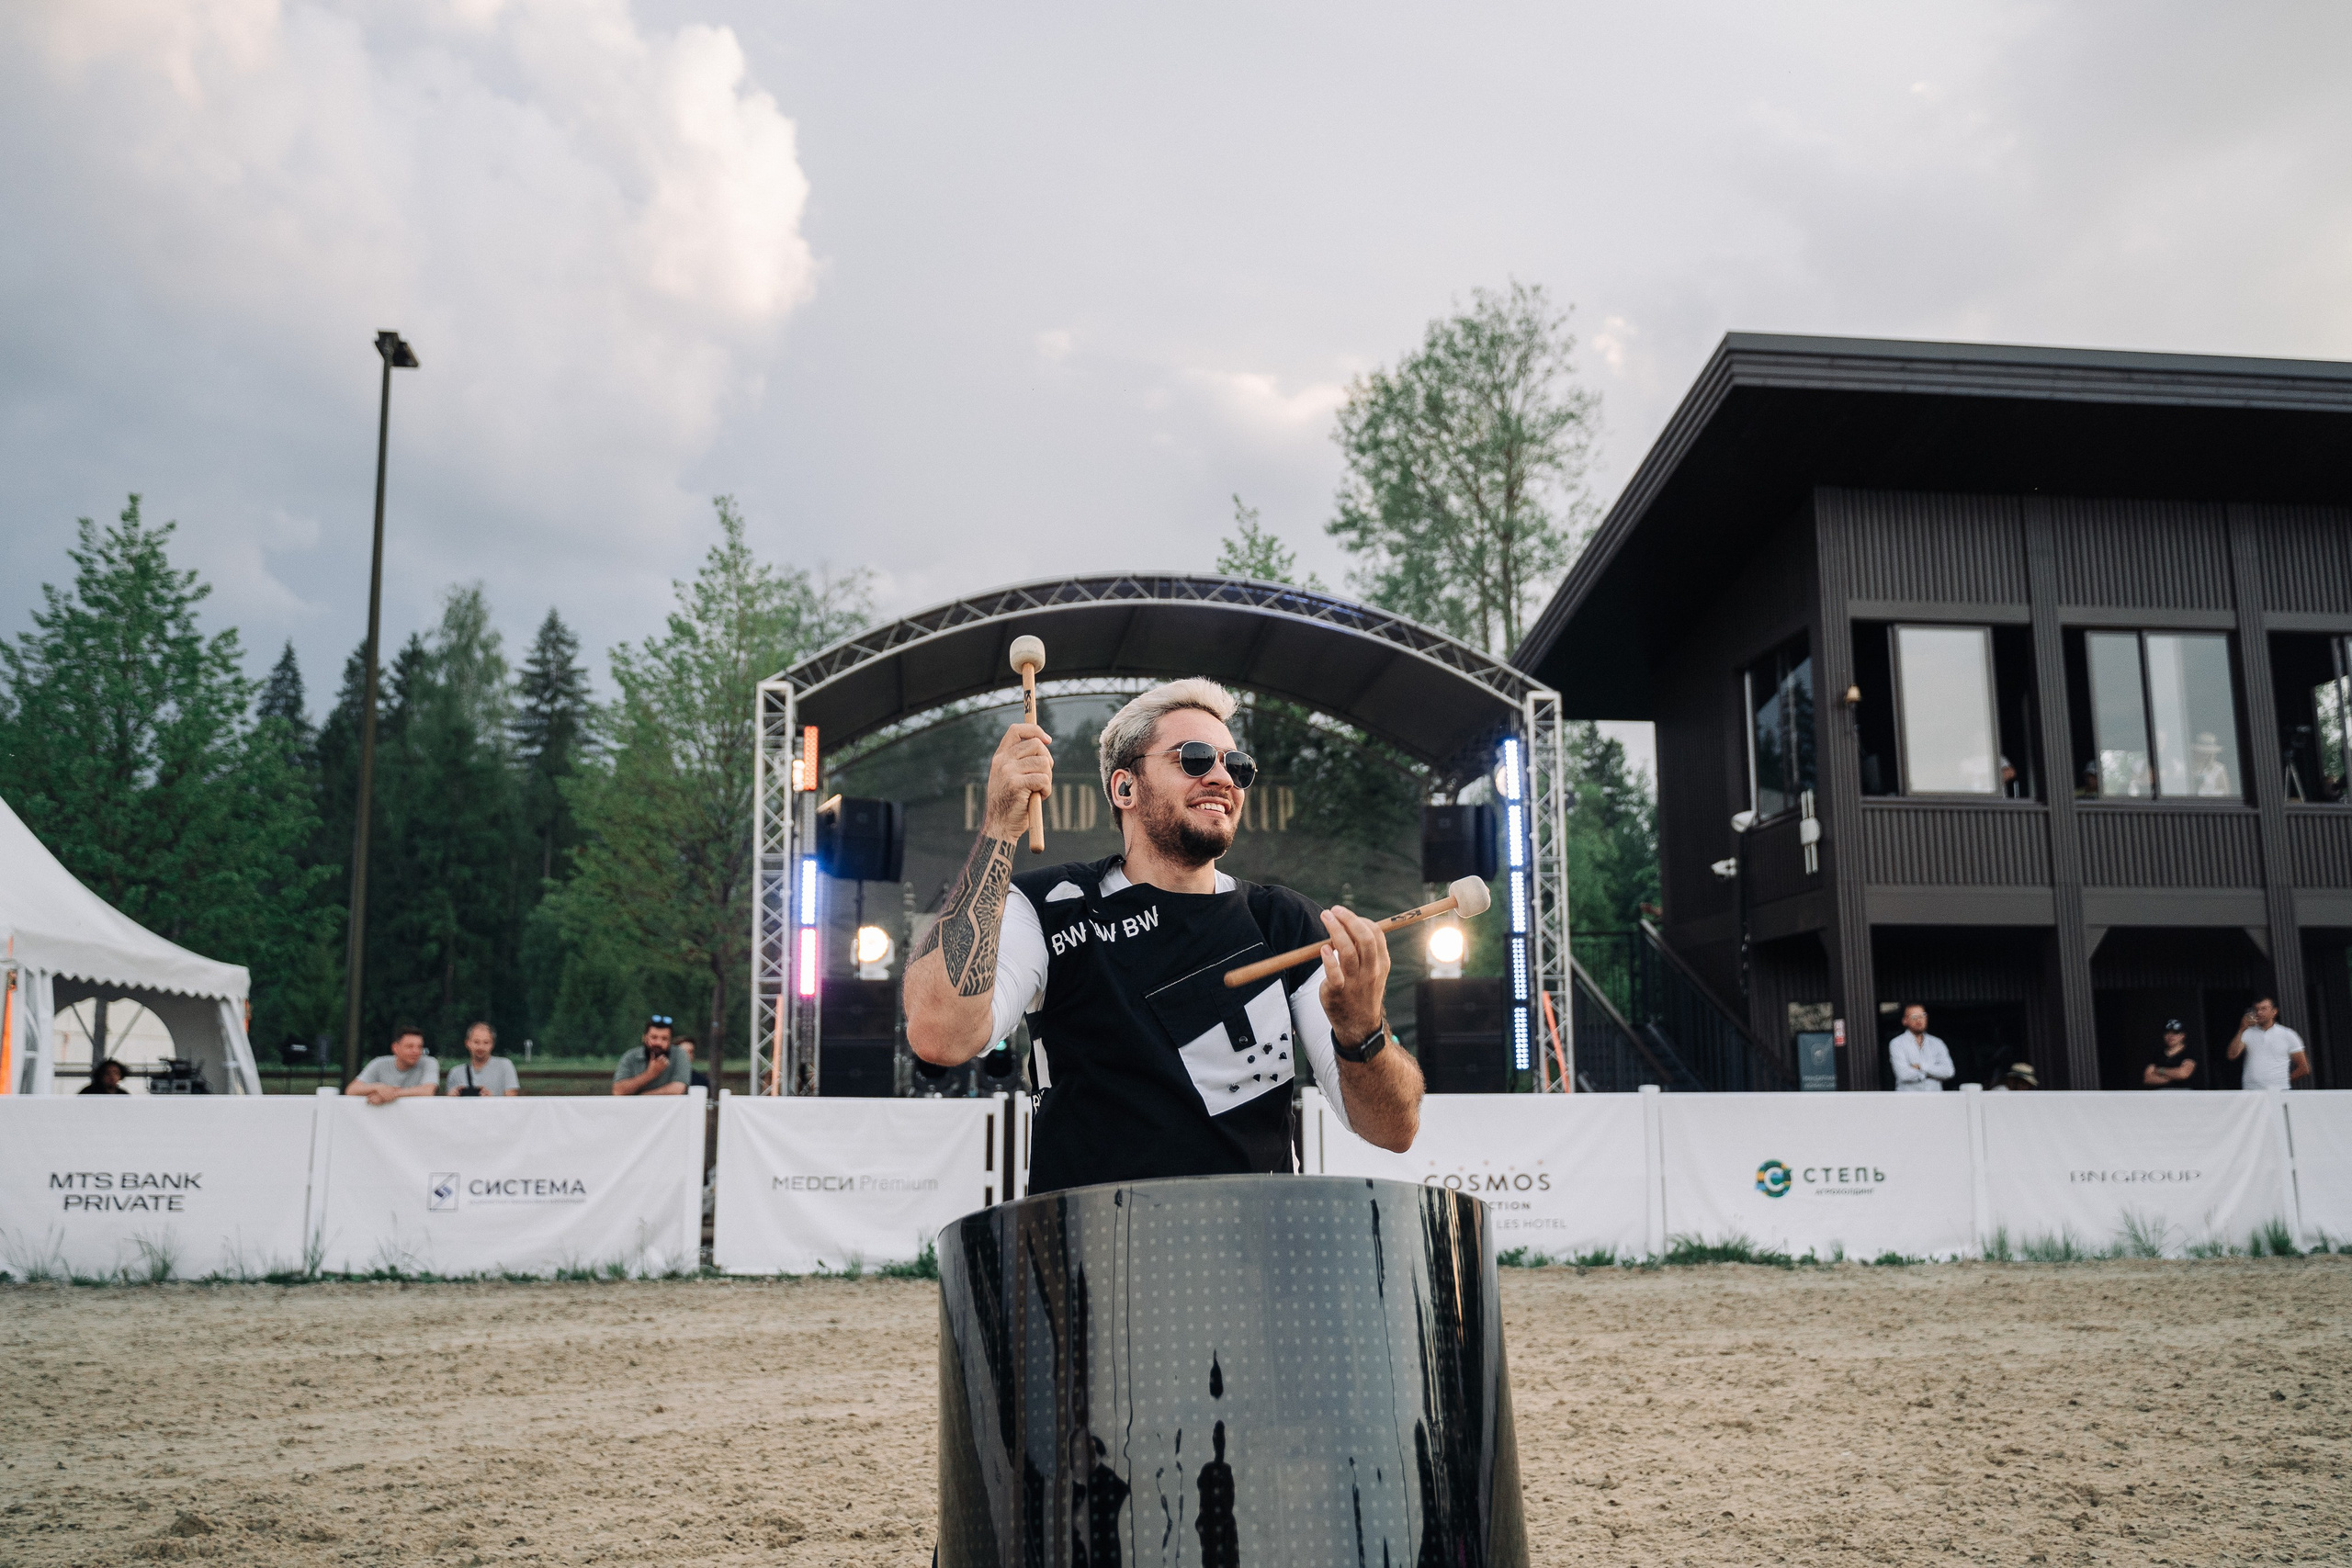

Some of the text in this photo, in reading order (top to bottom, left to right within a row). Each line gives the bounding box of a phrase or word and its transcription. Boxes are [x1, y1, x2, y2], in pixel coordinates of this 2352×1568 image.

[1051, 921, 1087, 955] BW
[1122, 905, 1159, 938] BW
[50, 1172, 203, 1189] MTS BANK
[1424, 1173, 1551, 1192] COSMOS
[1804, 1167, 1886, 1183] СТЕПЬ
[2111, 1169, 2201, 1183] GROUP
[469, 1179, 586, 1196] СИСТЕМА
[63, 1194, 185, 1211] PRIVATE
[1522, 1217, 1567, 1230] HOTEL
